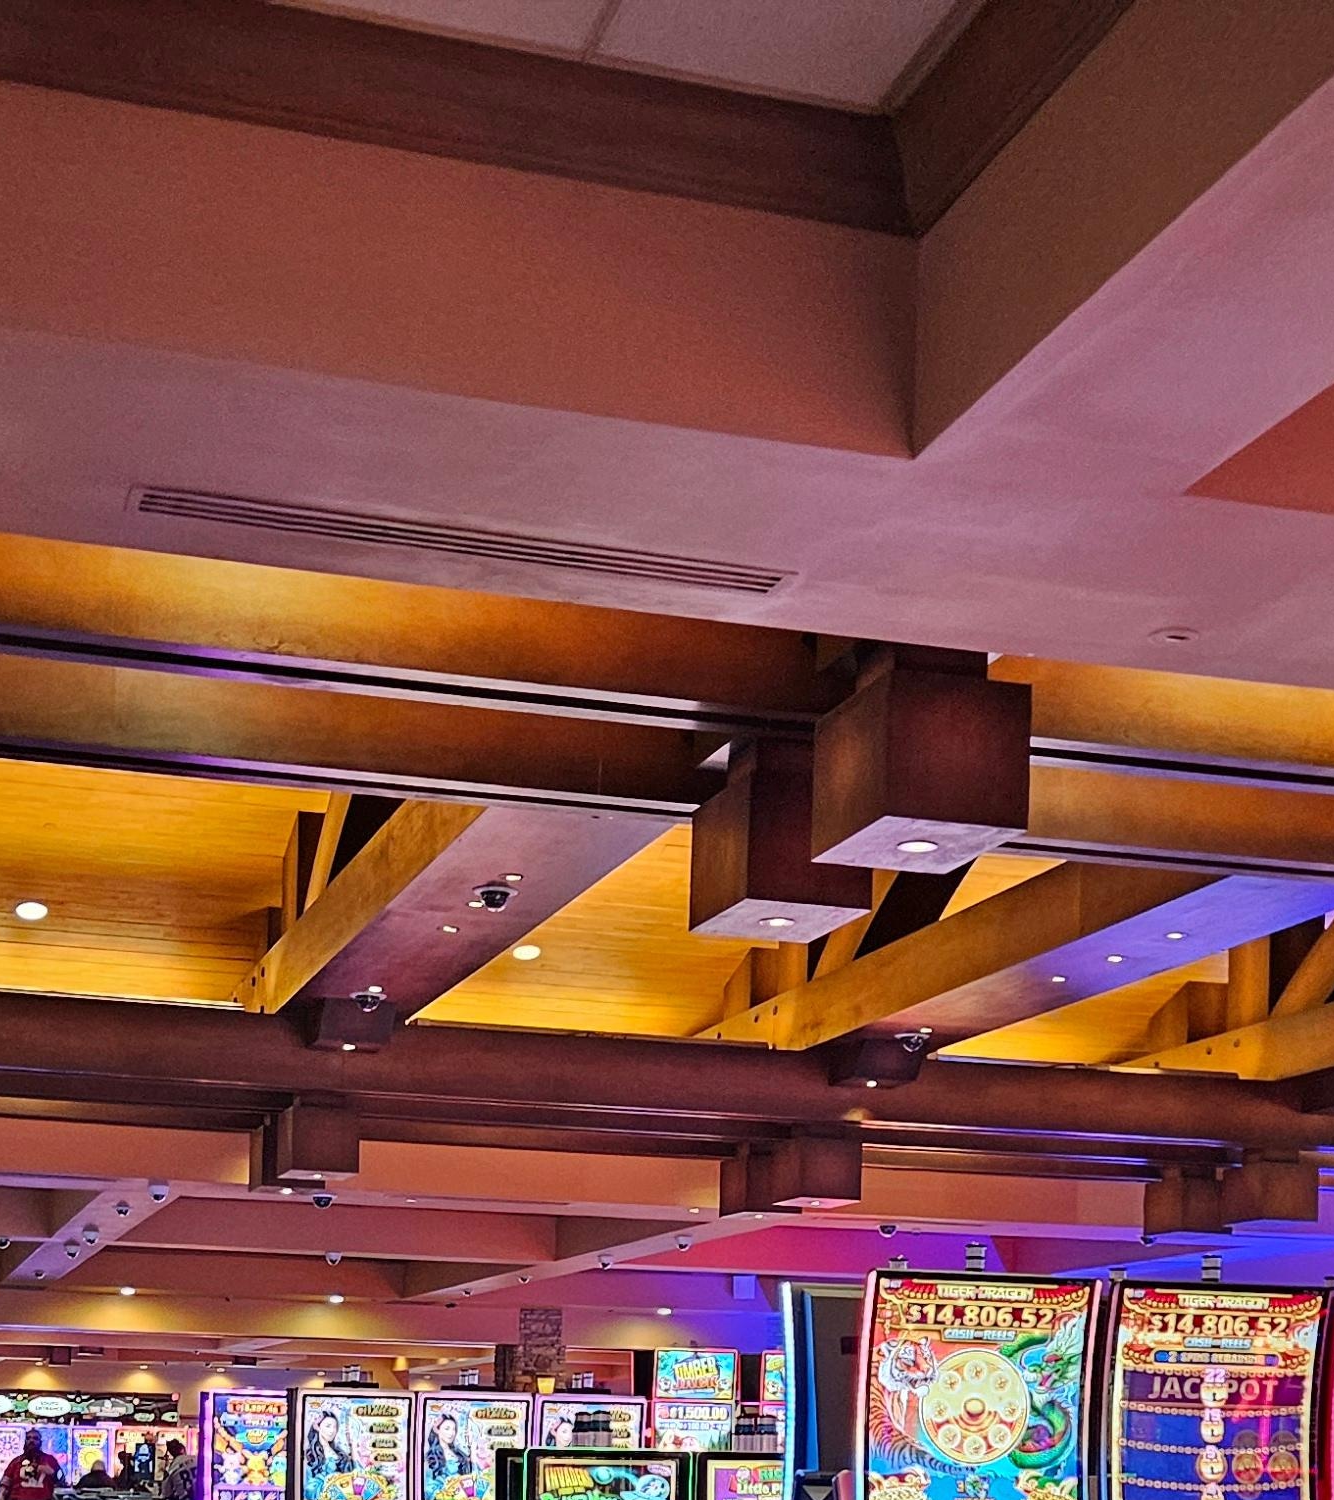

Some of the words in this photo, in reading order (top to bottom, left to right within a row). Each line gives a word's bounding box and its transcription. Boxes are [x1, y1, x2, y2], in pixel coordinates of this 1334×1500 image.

[938, 1284, 977, 1299] TIGER
[979, 1285, 1034, 1301] DRAGON
[1178, 1295, 1215, 1308] TIGER
[1217, 1296, 1269, 1310] DRAGON
[907, 1303, 1055, 1328] $14,806.52
[1150, 1313, 1289, 1338] $14,806.52
[1168, 1351, 1178, 1363] 2
[1205, 1368, 1227, 1383] 22
[1148, 1375, 1279, 1402] JACPOT
[957, 1481, 965, 1493] 3
